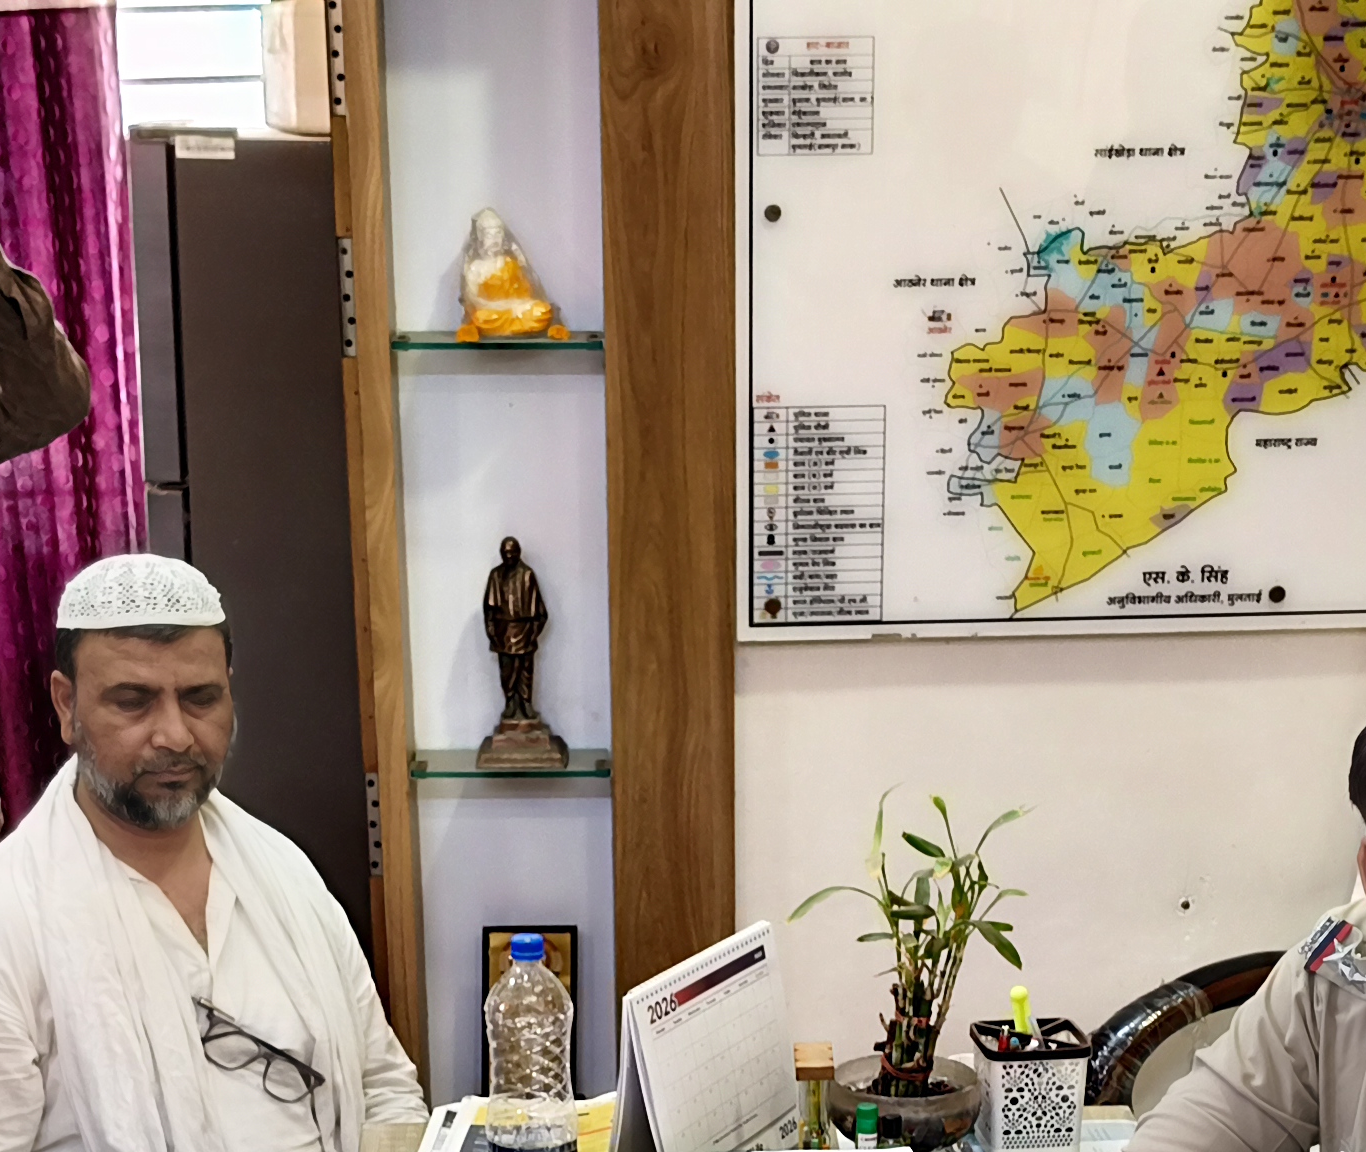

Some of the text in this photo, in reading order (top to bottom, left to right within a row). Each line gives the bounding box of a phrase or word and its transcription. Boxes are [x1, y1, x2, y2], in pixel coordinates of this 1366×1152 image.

[1142, 564, 1229, 587] एस. के. सिंह
[647, 993, 677, 1025] 2026
[779, 1117, 797, 1140] 2026
